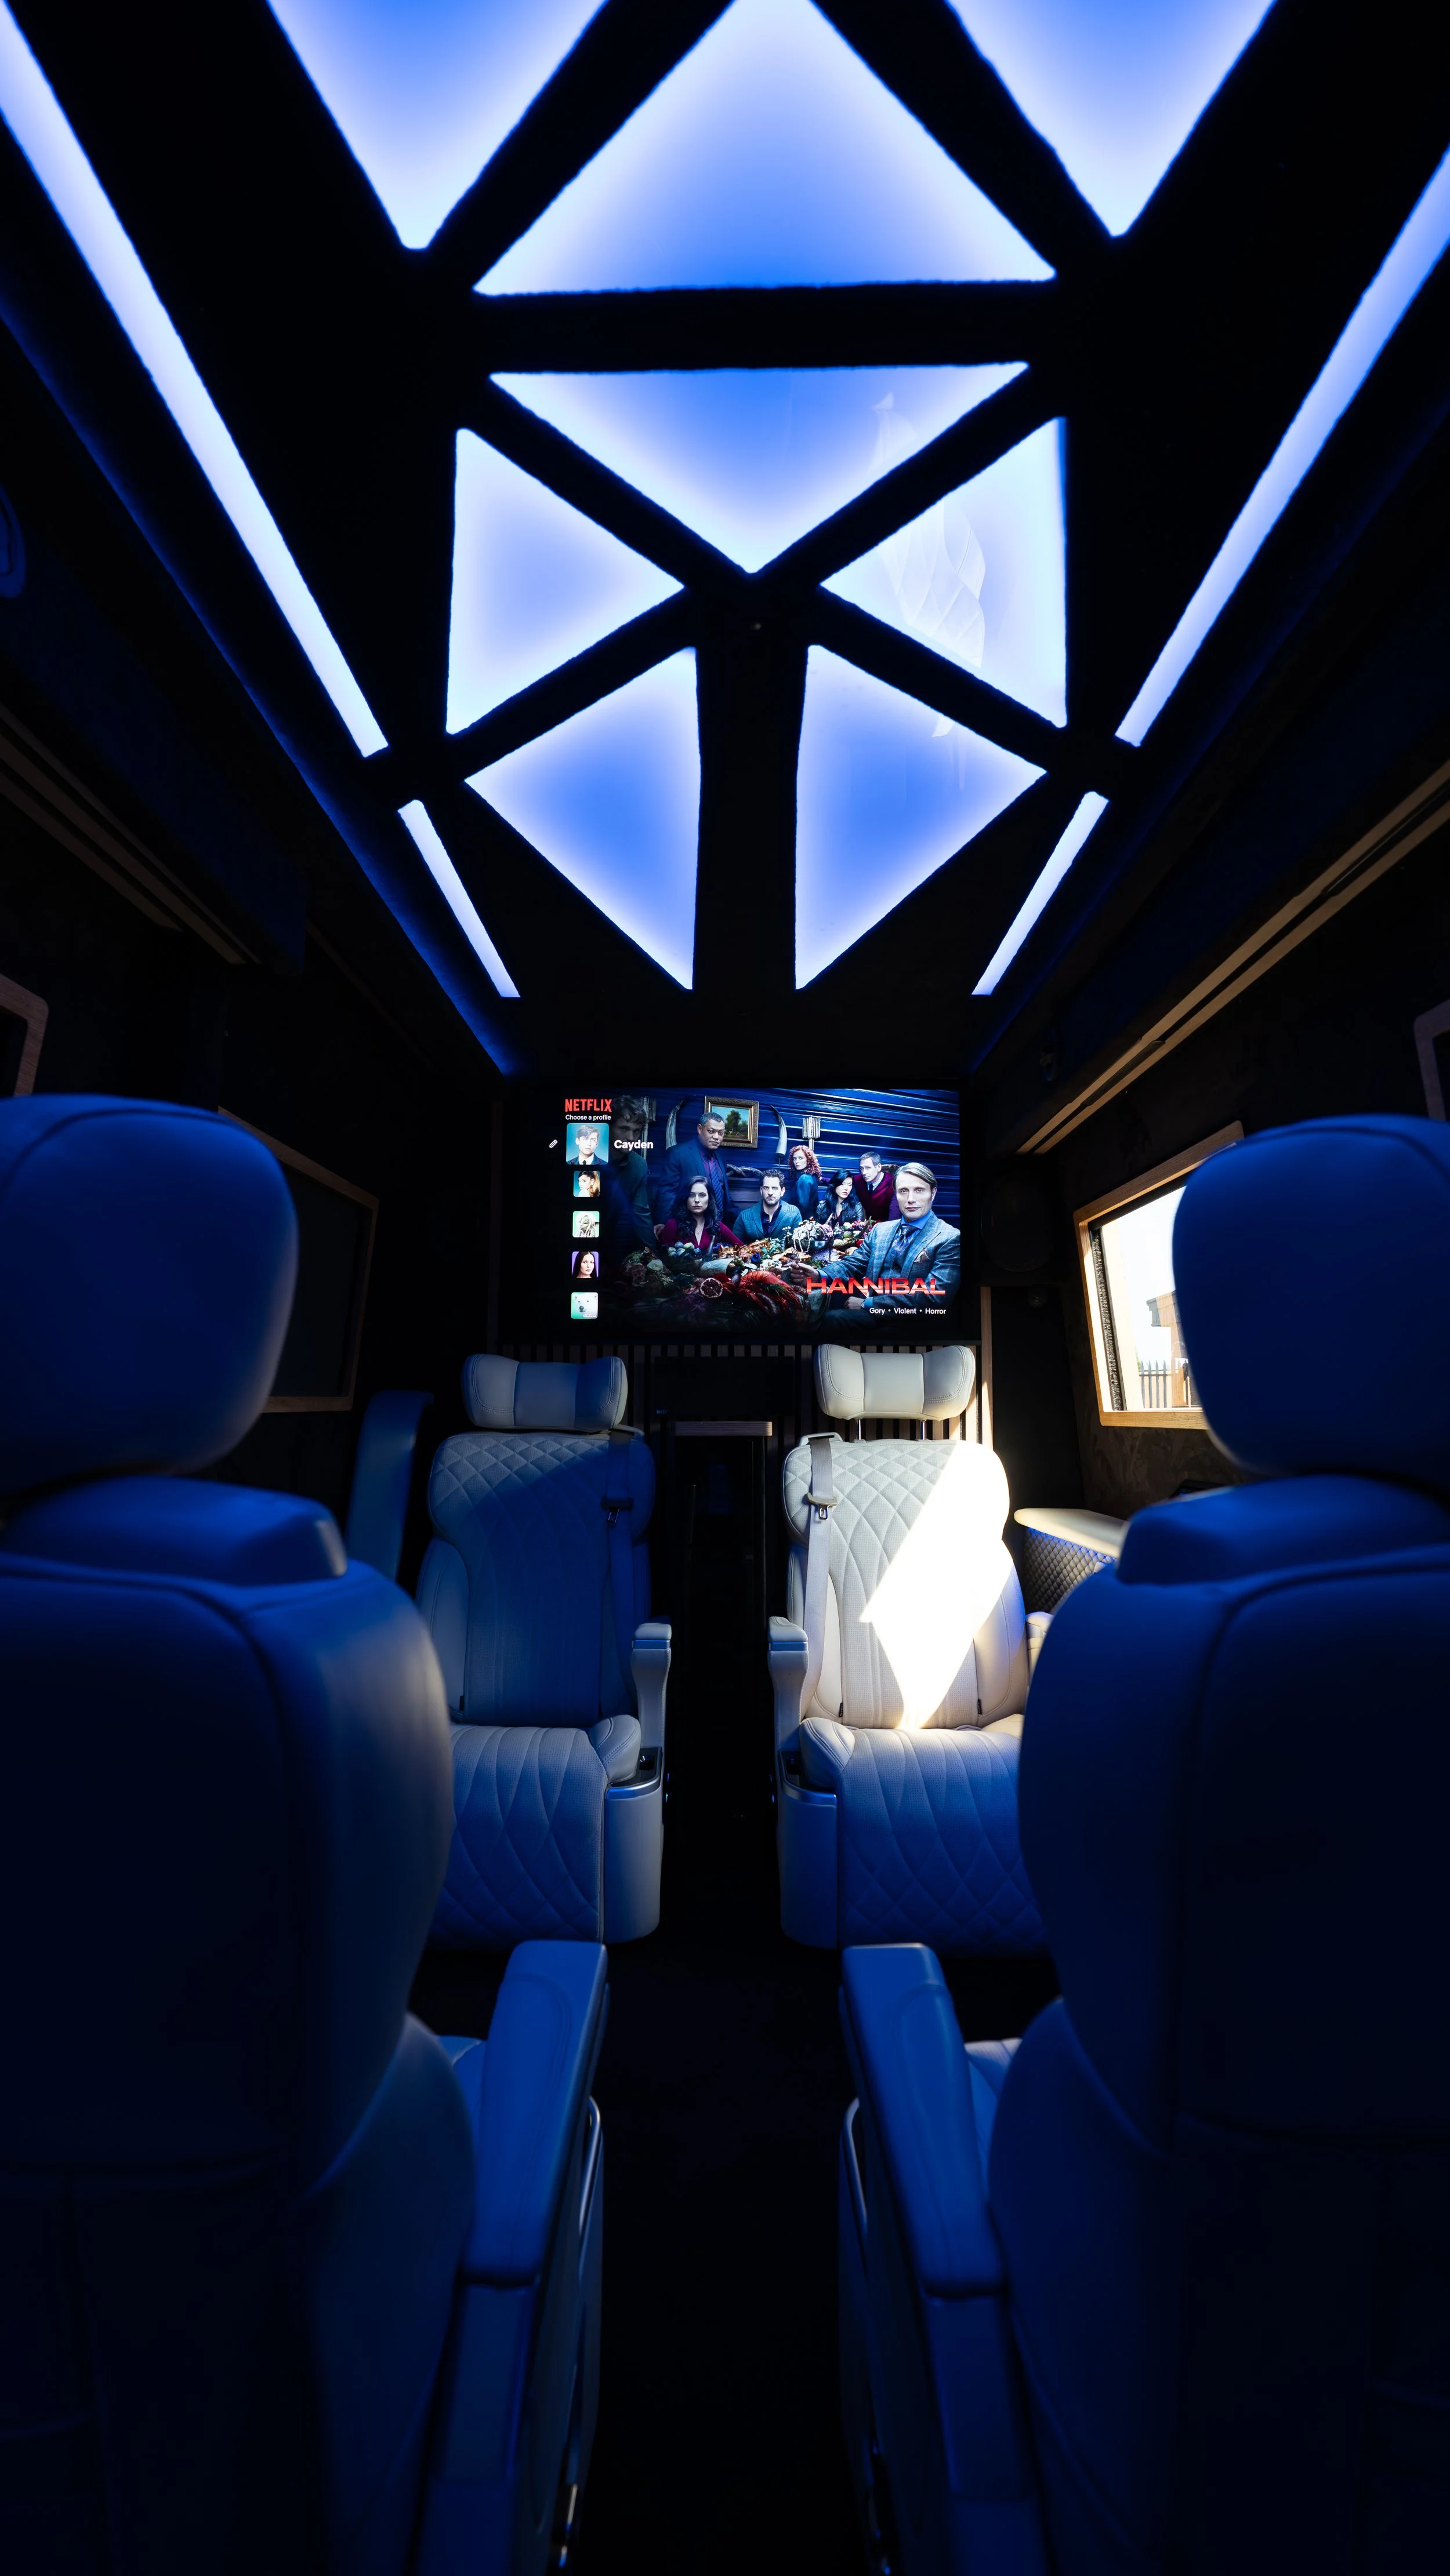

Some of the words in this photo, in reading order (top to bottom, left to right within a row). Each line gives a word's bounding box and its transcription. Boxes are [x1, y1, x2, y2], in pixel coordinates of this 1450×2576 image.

[565, 1099, 612, 1112] NETFLIX
[614, 1140, 654, 1151] Cayden
[806, 1278, 946, 1298] HANNIBAL
